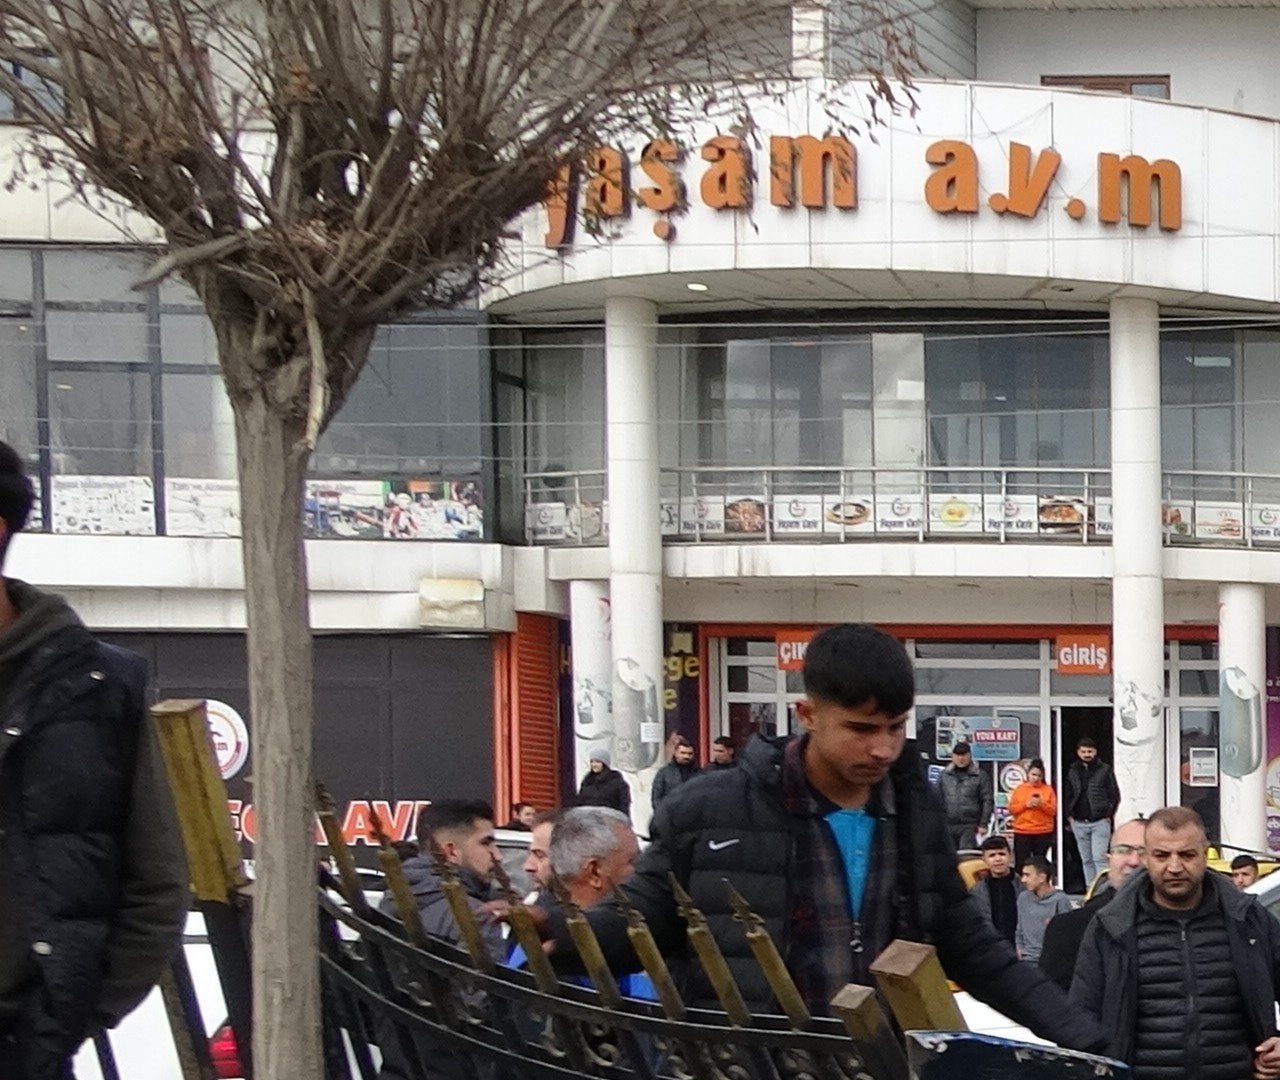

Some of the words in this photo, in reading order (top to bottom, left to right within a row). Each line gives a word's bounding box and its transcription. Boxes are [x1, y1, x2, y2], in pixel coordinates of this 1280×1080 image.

[924, 138, 1182, 231] a.v.m
[780, 641, 809, 664] ÇIK
[1060, 643, 1107, 669] GİRİŞ
